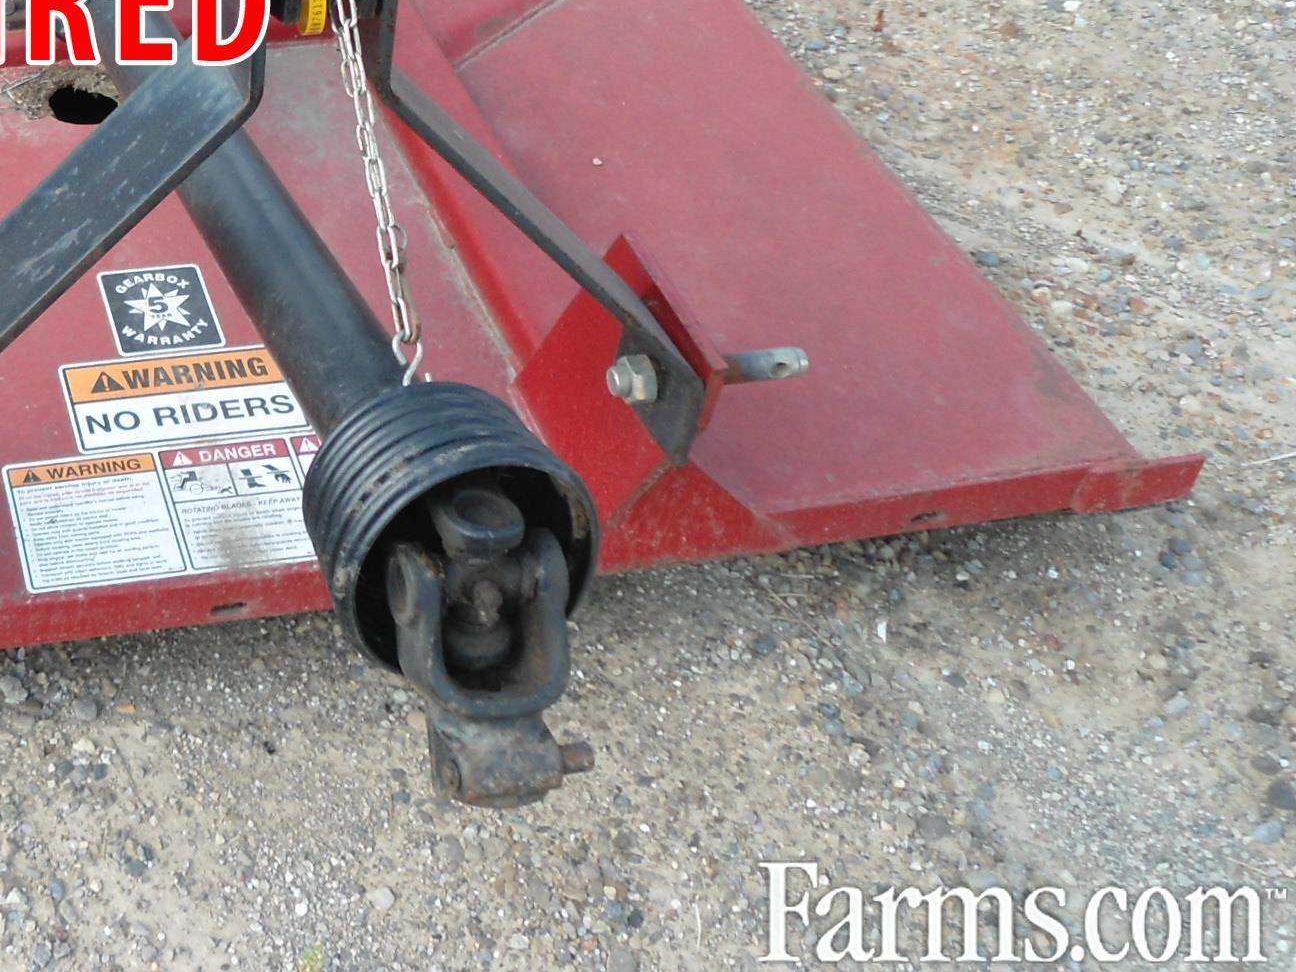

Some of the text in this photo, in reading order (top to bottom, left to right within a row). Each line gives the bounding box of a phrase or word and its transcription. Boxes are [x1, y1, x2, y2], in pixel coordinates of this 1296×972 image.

[115, 273, 190, 294] GEARBOX
[148, 296, 169, 313] 5
[122, 318, 208, 345] WARRANTY
[122, 357, 268, 390] WARNING
[85, 395, 295, 435] NO RIDERS
[199, 443, 276, 463] DANGER
[46, 459, 141, 479] WARNING
